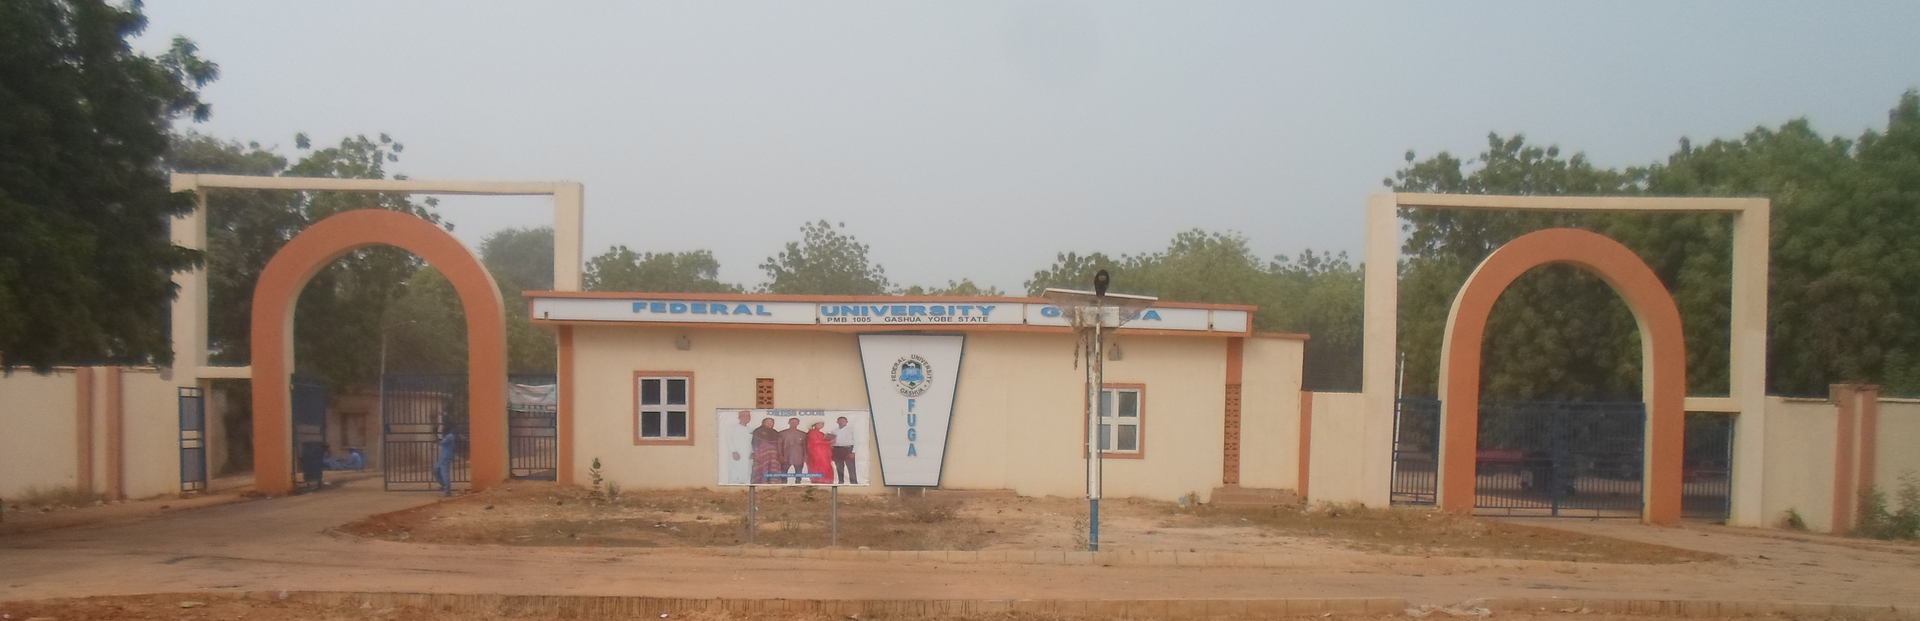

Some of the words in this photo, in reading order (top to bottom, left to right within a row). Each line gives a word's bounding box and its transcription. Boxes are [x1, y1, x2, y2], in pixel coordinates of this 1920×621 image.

[632, 302, 773, 316] FEDERAL
[820, 305, 996, 316] UNIVERSITY
[891, 357, 906, 382] FEDERAL
[911, 355, 931, 383] UNIVERSITY
[907, 399, 917, 457] FUGA
